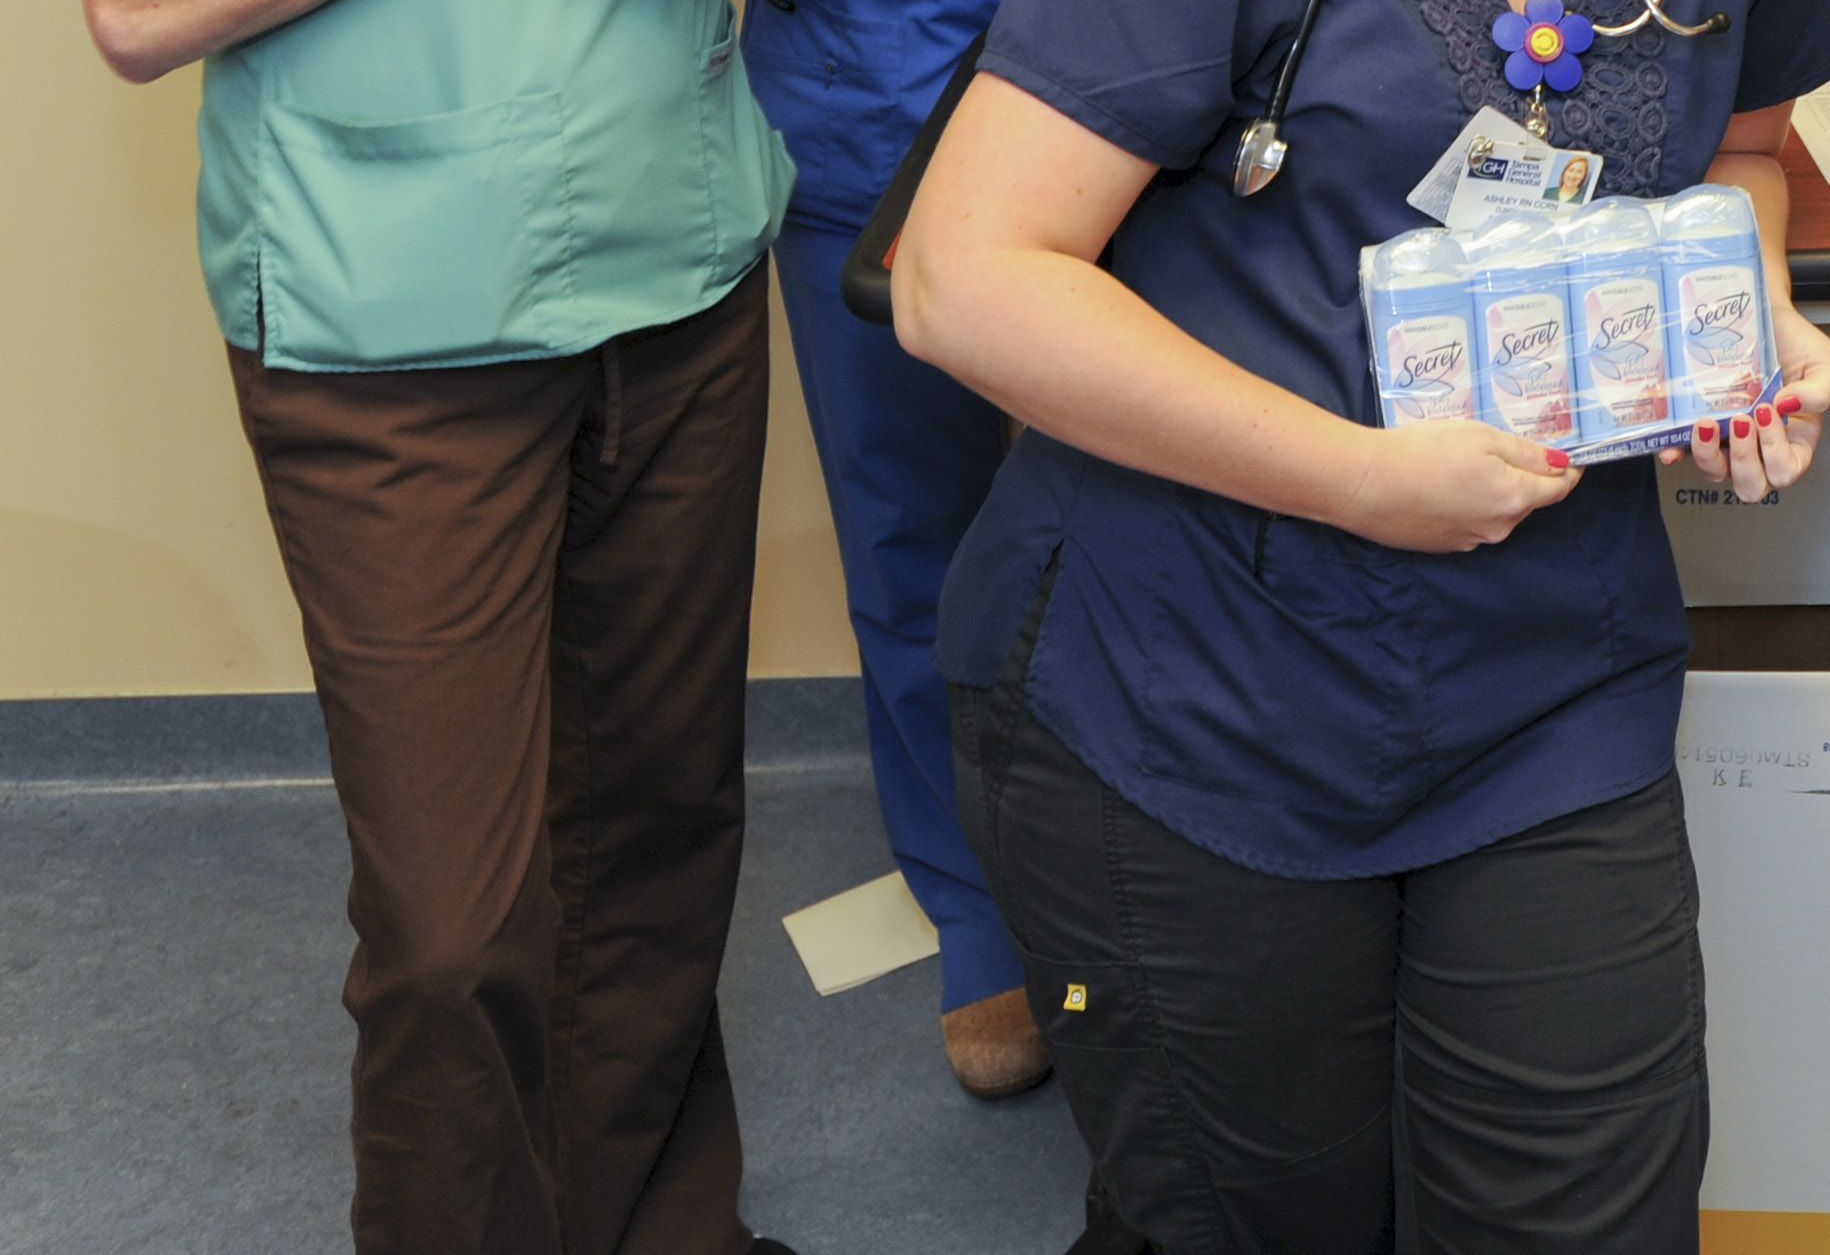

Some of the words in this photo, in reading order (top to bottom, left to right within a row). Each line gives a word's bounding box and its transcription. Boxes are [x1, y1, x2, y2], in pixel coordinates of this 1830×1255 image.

[1483, 194, 1518, 205] ASHLEY
[1595, 303, 1656, 350] Secret
[1689, 290, 1751, 336] Secret
[1398, 340, 1463, 389] Secret
[1496, 319, 1559, 367] Secret
[1675, 489, 1719, 505] CTN#
